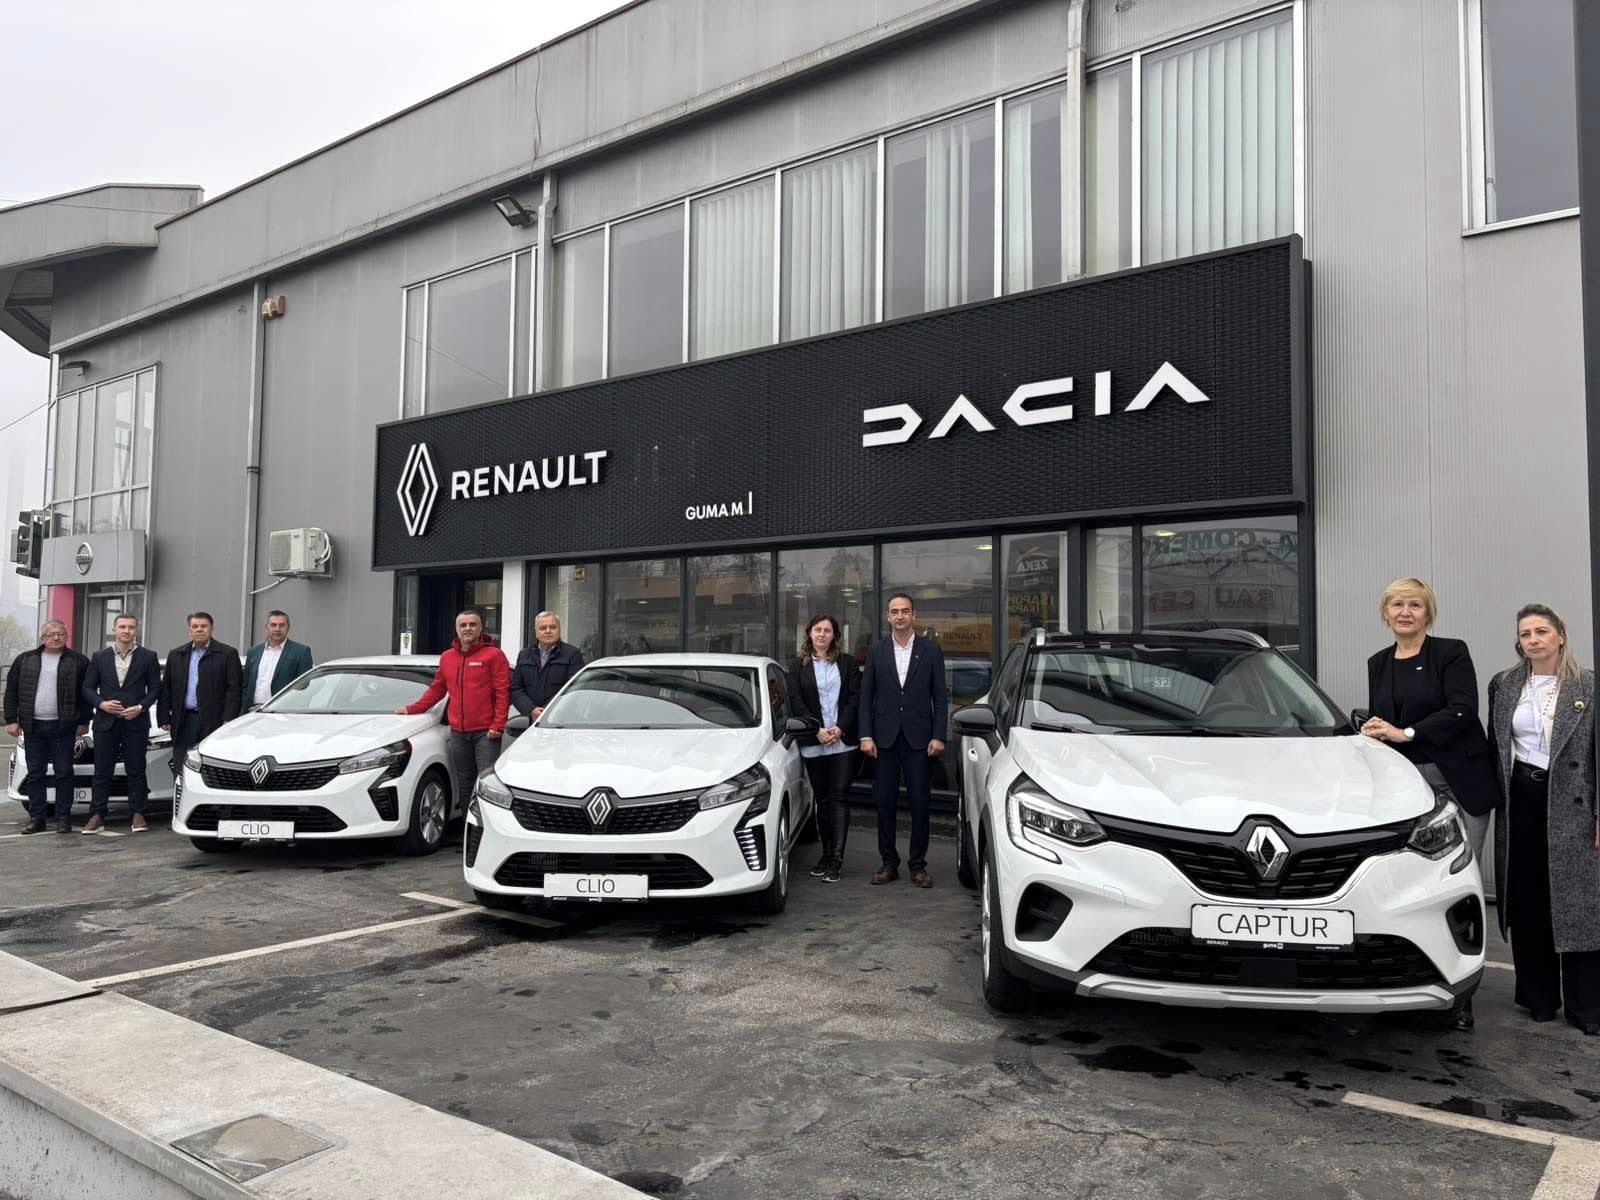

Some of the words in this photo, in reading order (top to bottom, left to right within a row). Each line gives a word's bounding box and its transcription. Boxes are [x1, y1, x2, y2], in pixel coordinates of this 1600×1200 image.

[862, 361, 1210, 447] DACIA
[451, 450, 607, 500] RENAULT
[241, 823, 270, 835] CLIO
[576, 878, 615, 893] CLIO
[1217, 913, 1328, 938] CAPTUR
